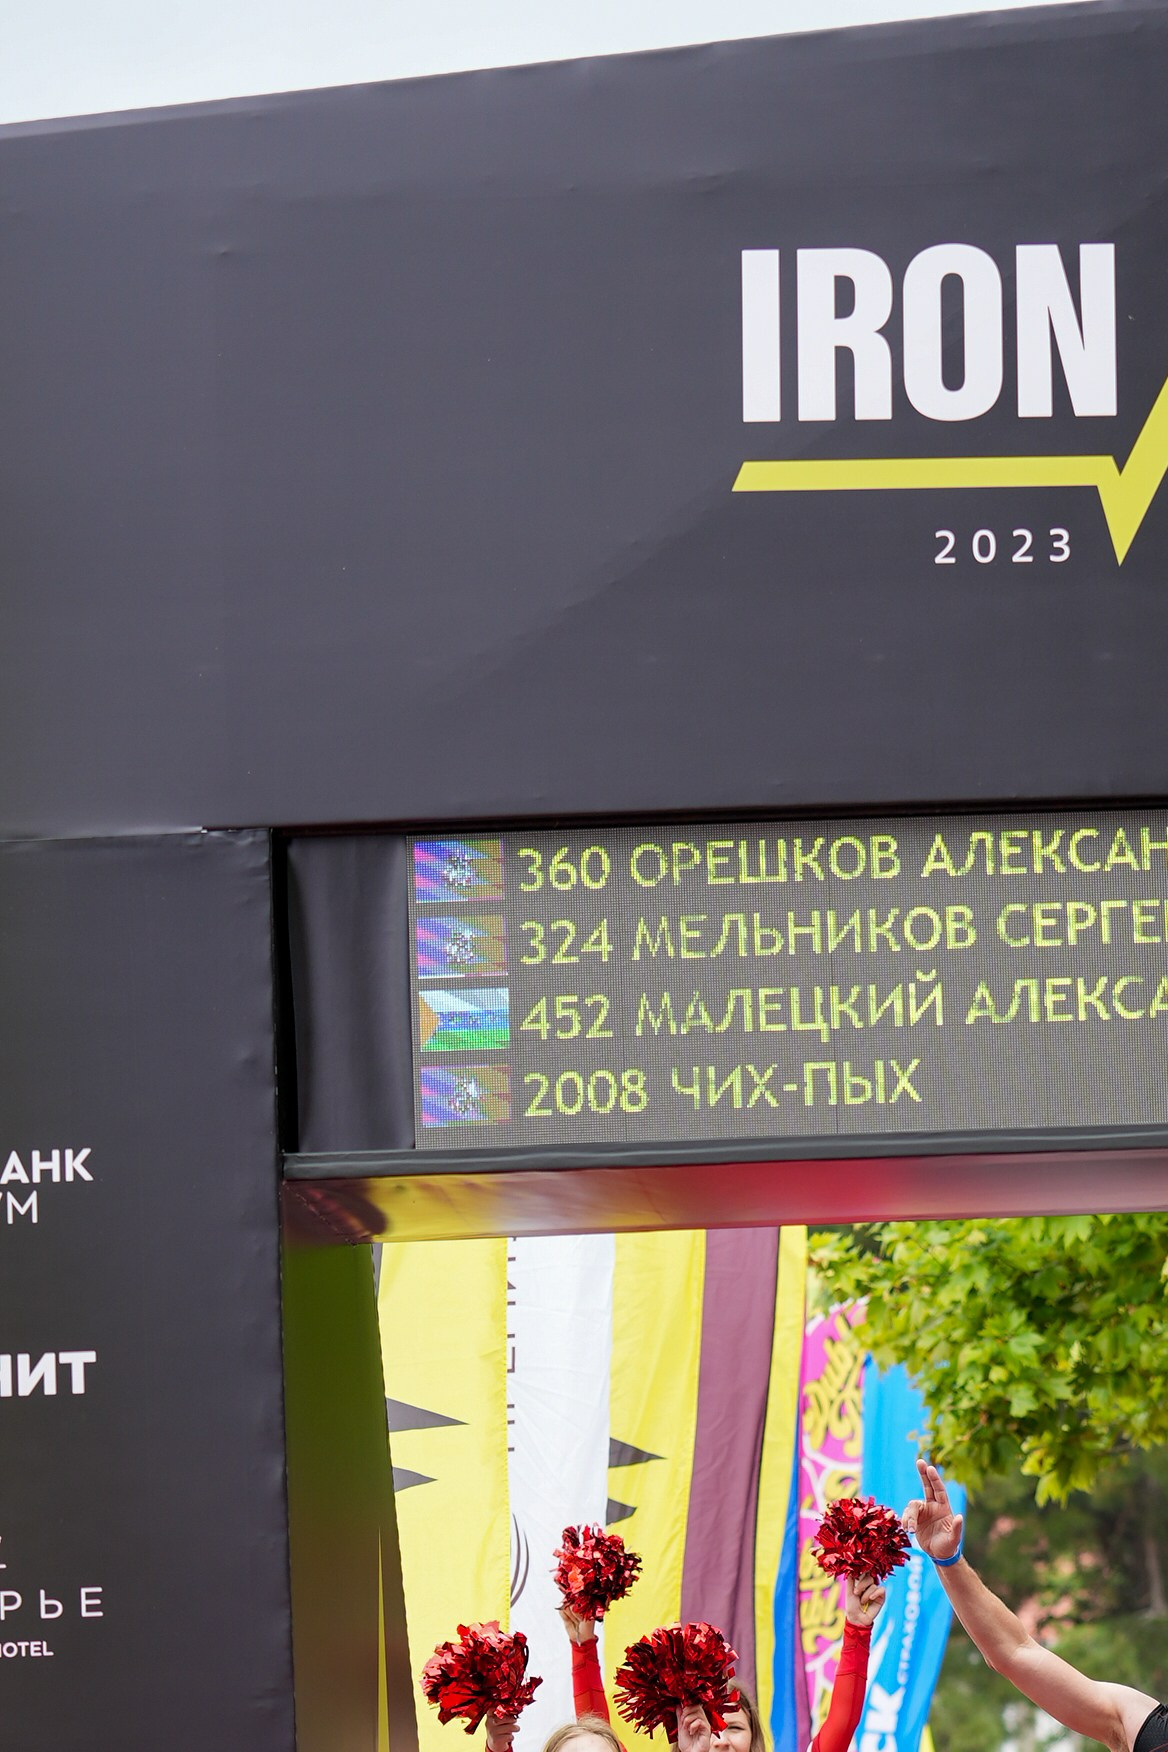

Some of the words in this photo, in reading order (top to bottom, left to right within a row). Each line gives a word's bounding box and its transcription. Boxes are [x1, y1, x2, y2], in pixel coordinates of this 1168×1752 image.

[741, 243, 1118, 422] IRON
[934, 528, 1072, 564] 2023
[518, 845, 611, 894] 360
[629, 836, 902, 888] ОРЕШКОВ
[520, 918, 613, 965] 324
[632, 907, 977, 962] МЕЛЬНИКОВ
[521, 993, 615, 1040] 452
[636, 969, 943, 1042] МАЛЕЦКИЙ
[523, 1069, 648, 1116] 2008
[671, 1058, 922, 1109] ЧИХ-ПЫХ
[0, 1190, 38, 1224] М
[0, 1641, 54, 1658] OTEL
